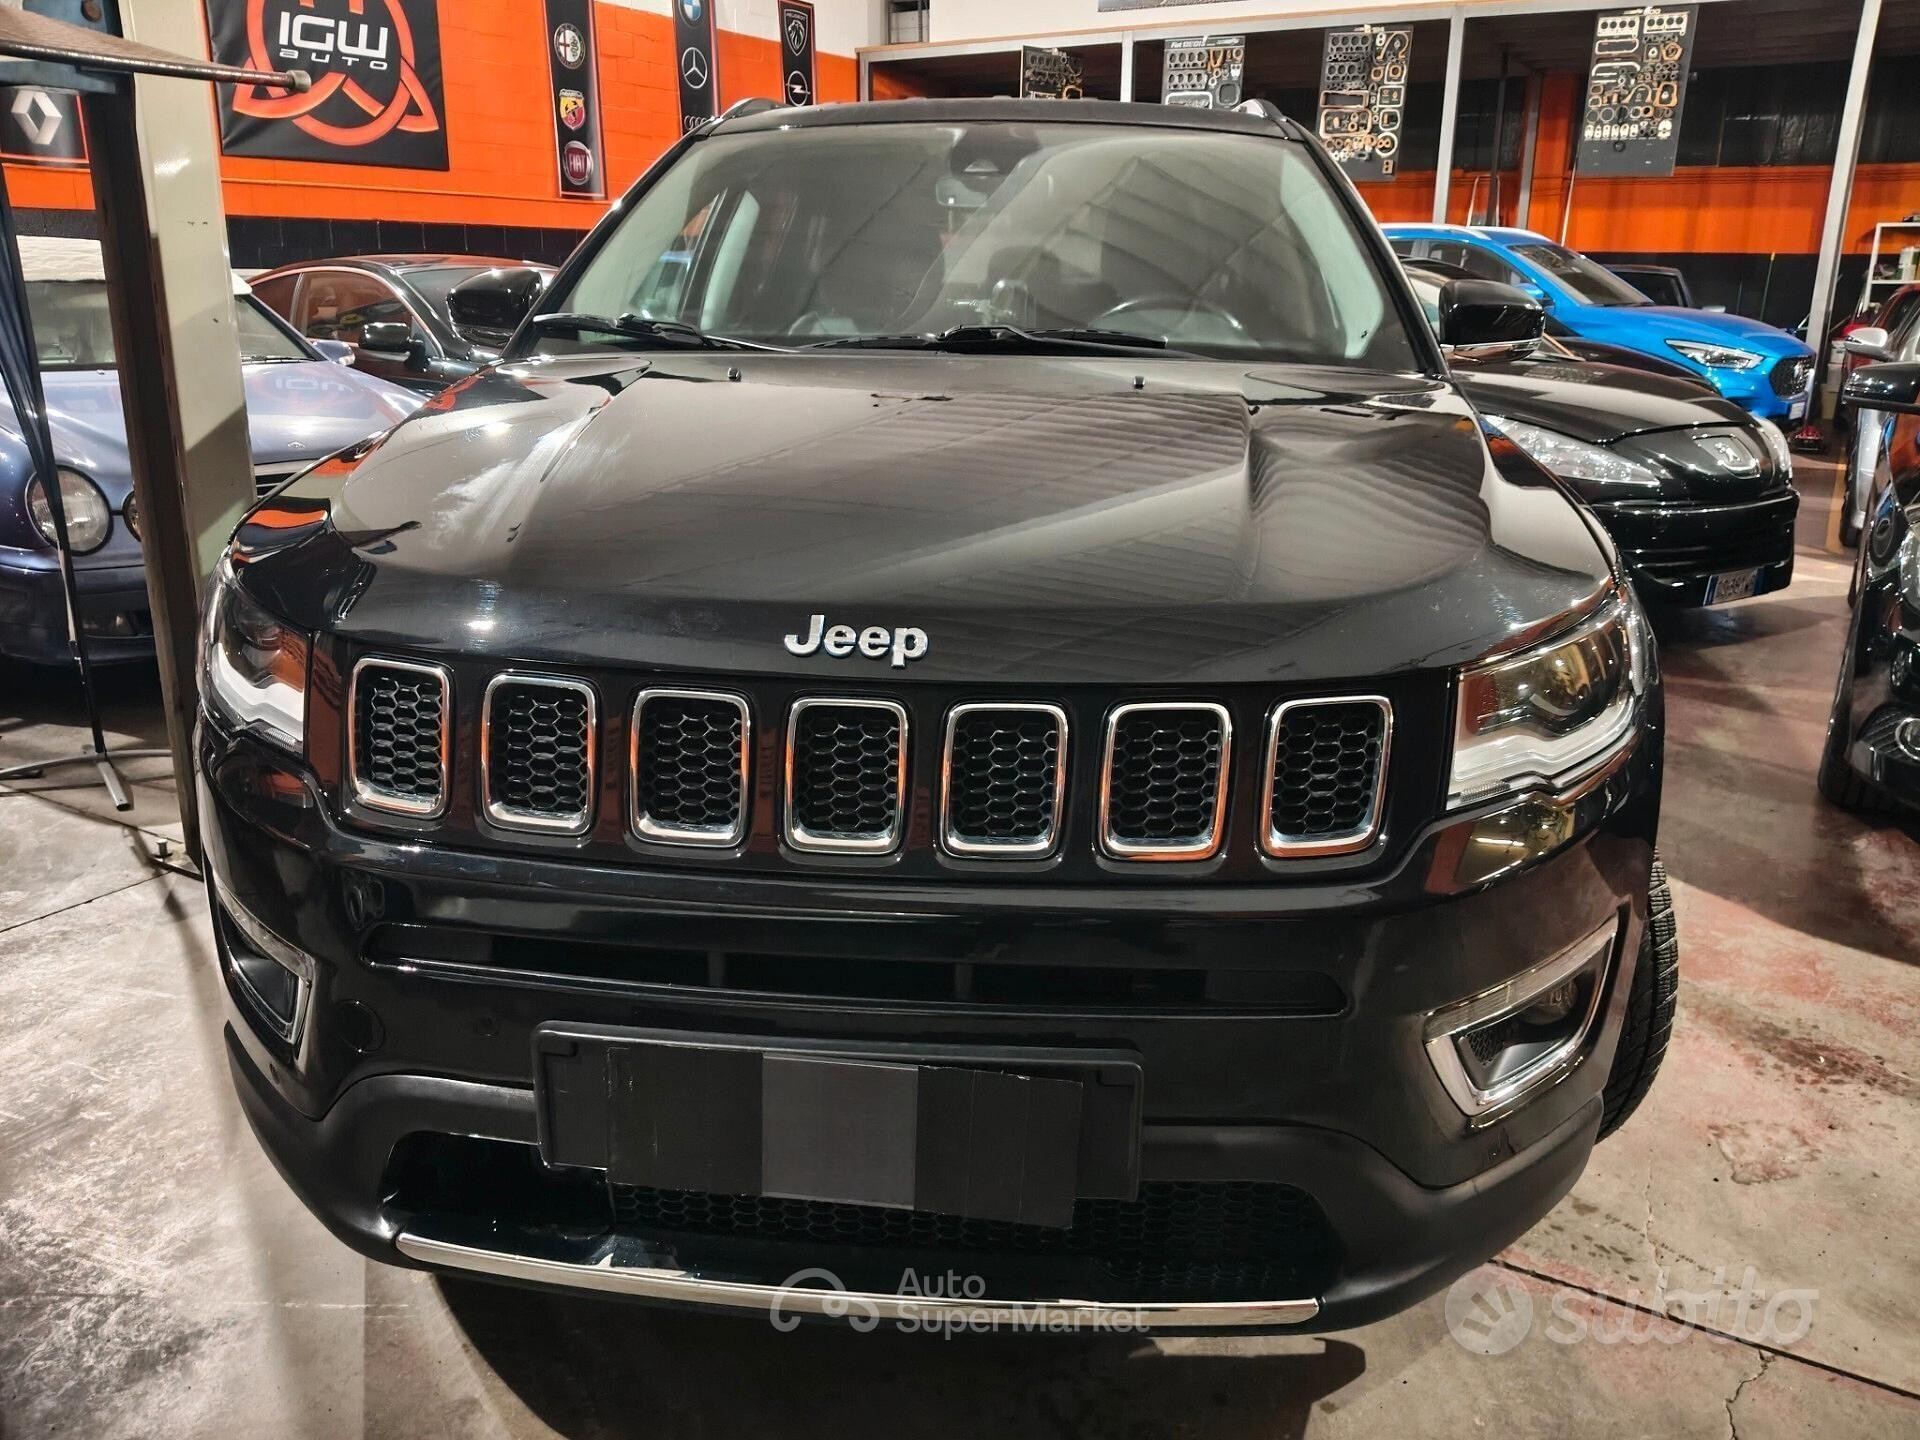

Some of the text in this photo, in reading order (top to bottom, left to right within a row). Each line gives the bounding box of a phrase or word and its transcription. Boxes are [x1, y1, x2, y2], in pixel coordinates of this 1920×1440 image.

[279, 11, 388, 59] IGW
[568, 152, 586, 173] FIAT
[784, 614, 929, 669] Jeep
